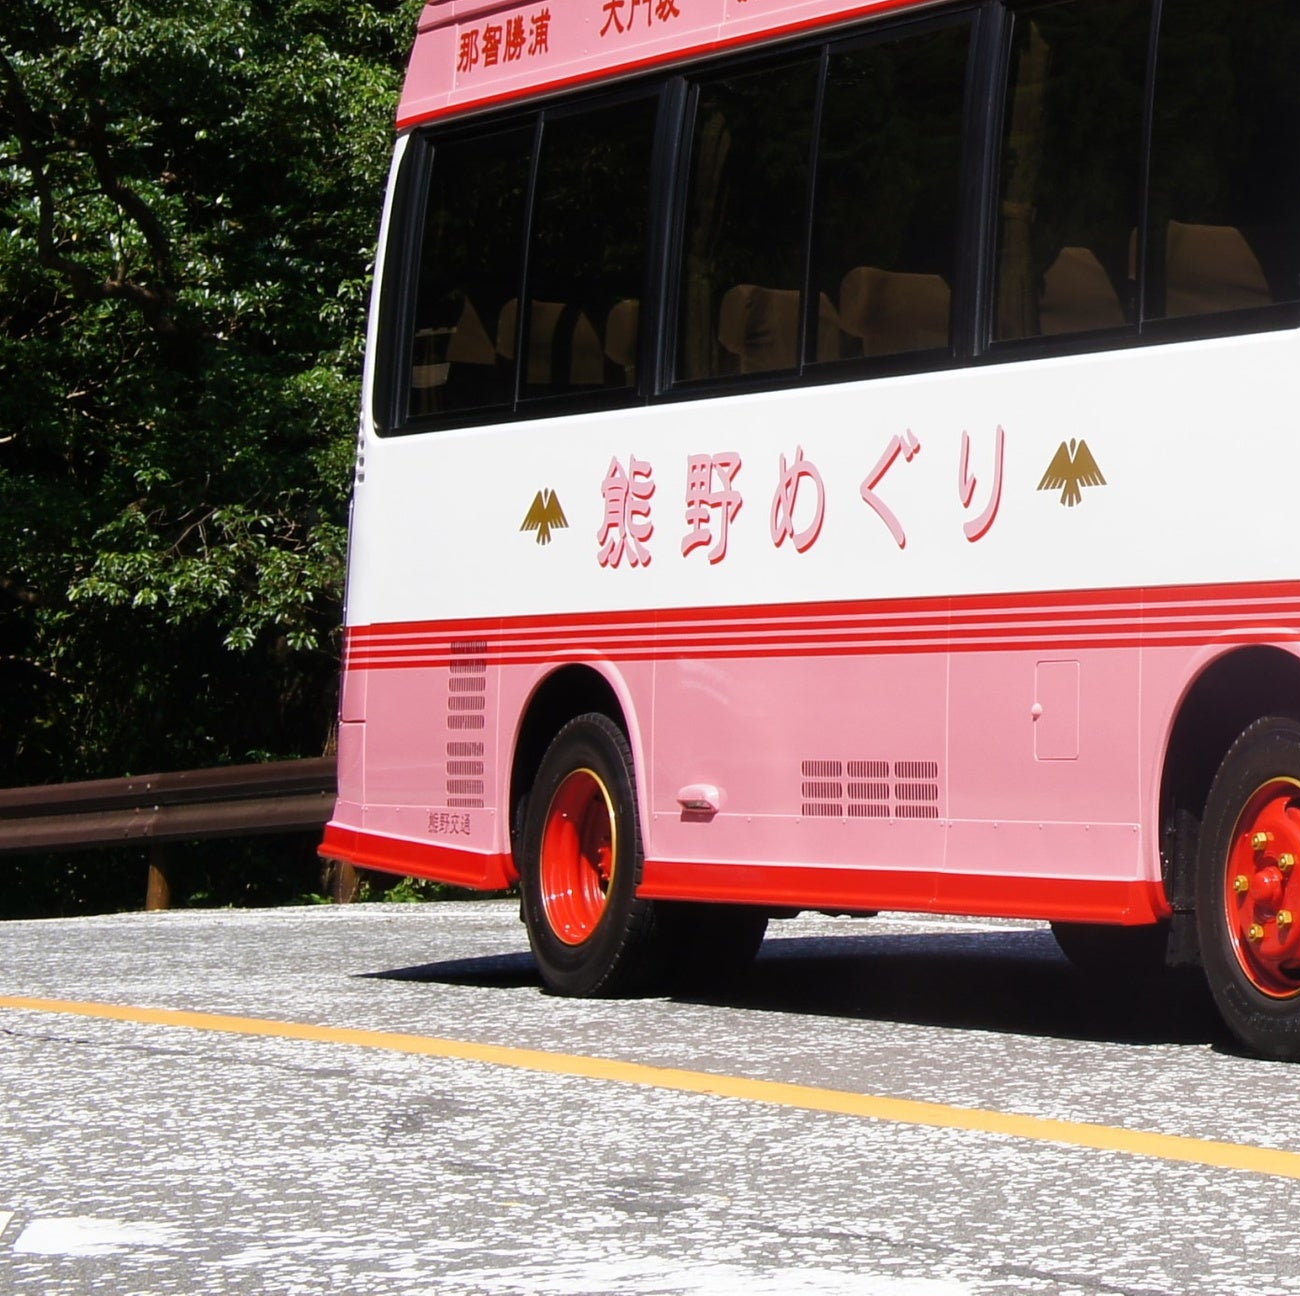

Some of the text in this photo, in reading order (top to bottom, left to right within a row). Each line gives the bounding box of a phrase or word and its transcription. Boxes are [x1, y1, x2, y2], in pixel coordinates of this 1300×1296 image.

[457, 8, 551, 72] 那智勝浦
[597, 424, 1004, 569] 熊野めぐり
[428, 812, 470, 835] 熊野交通
